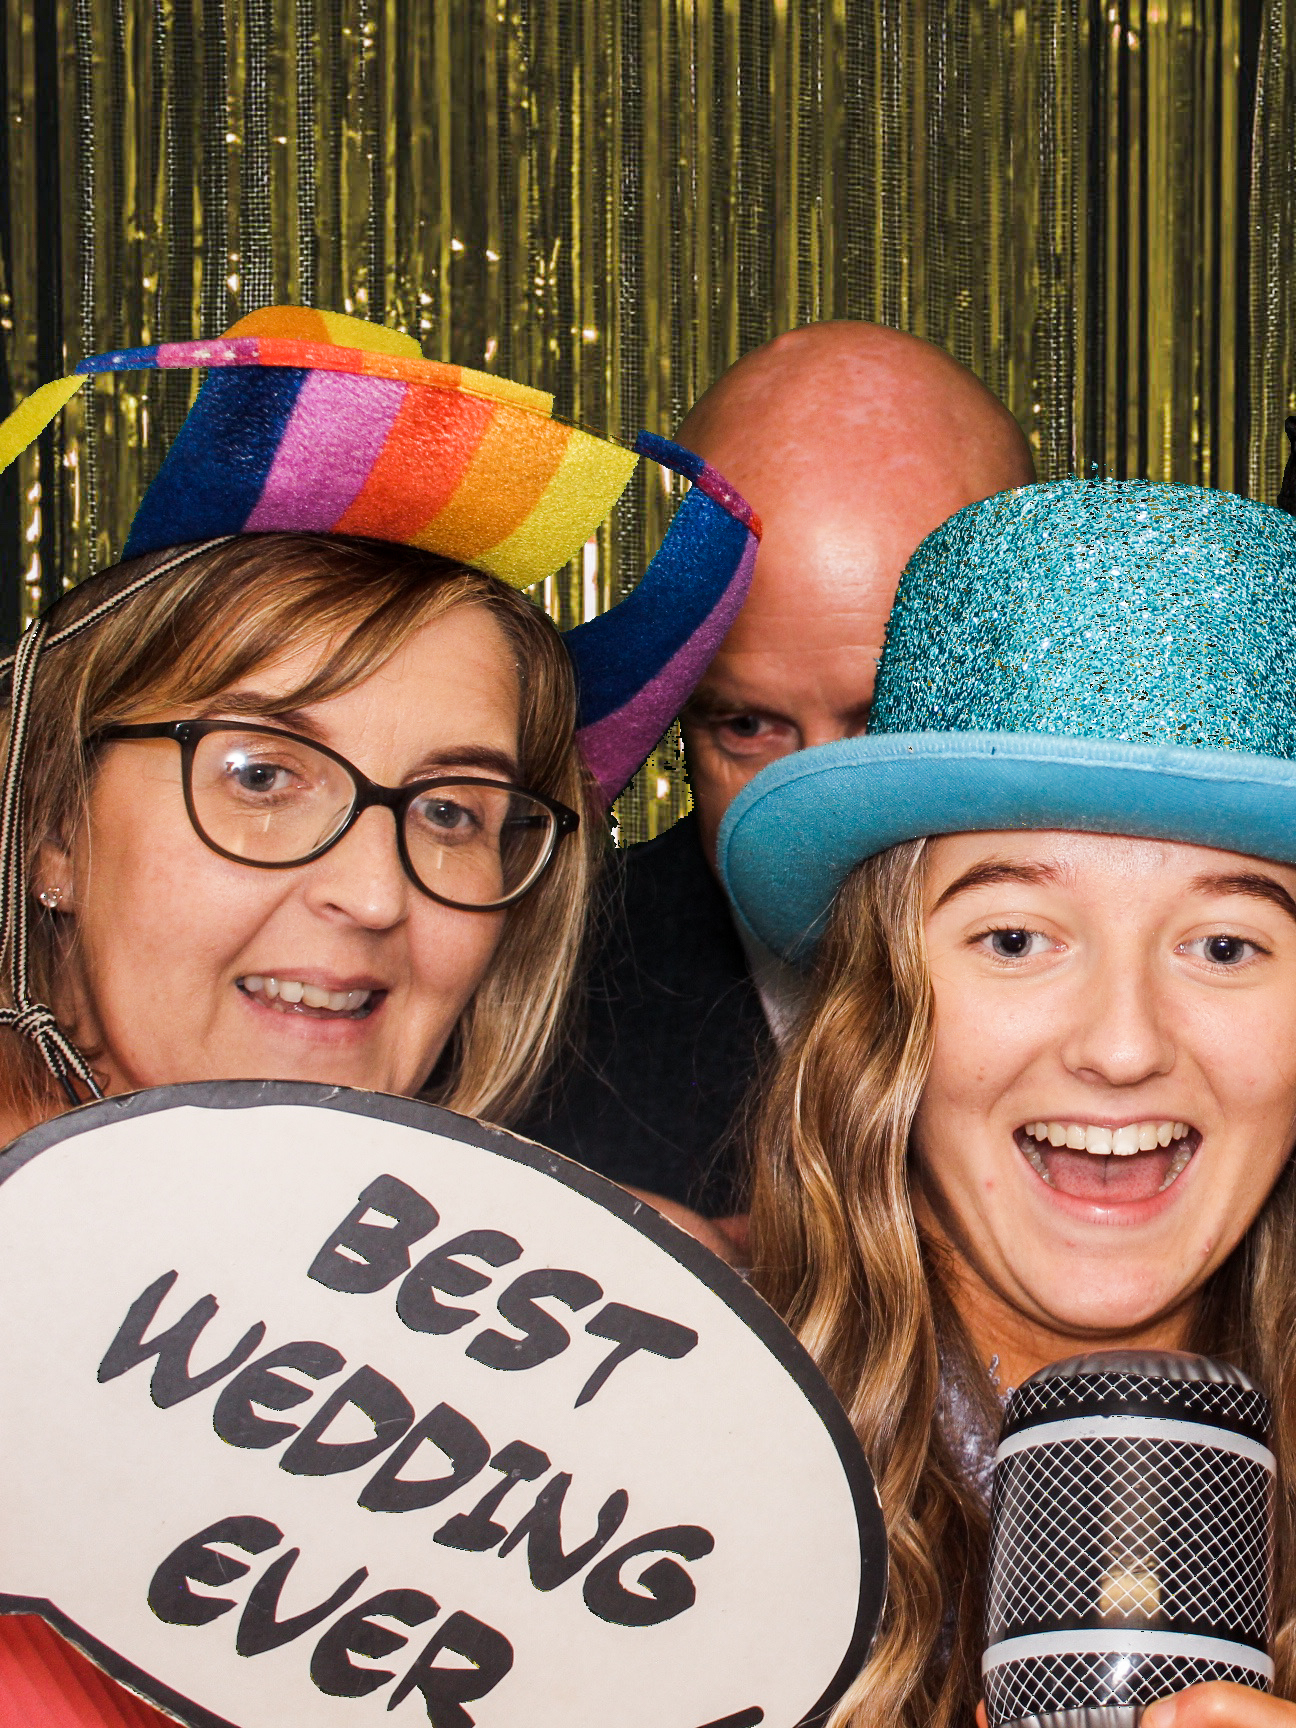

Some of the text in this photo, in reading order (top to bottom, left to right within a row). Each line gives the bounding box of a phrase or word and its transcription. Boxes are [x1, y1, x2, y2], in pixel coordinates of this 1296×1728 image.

[307, 1174, 699, 1410] BEST
[97, 1270, 715, 1628] WEDDING
[147, 1516, 514, 1728] EVER
